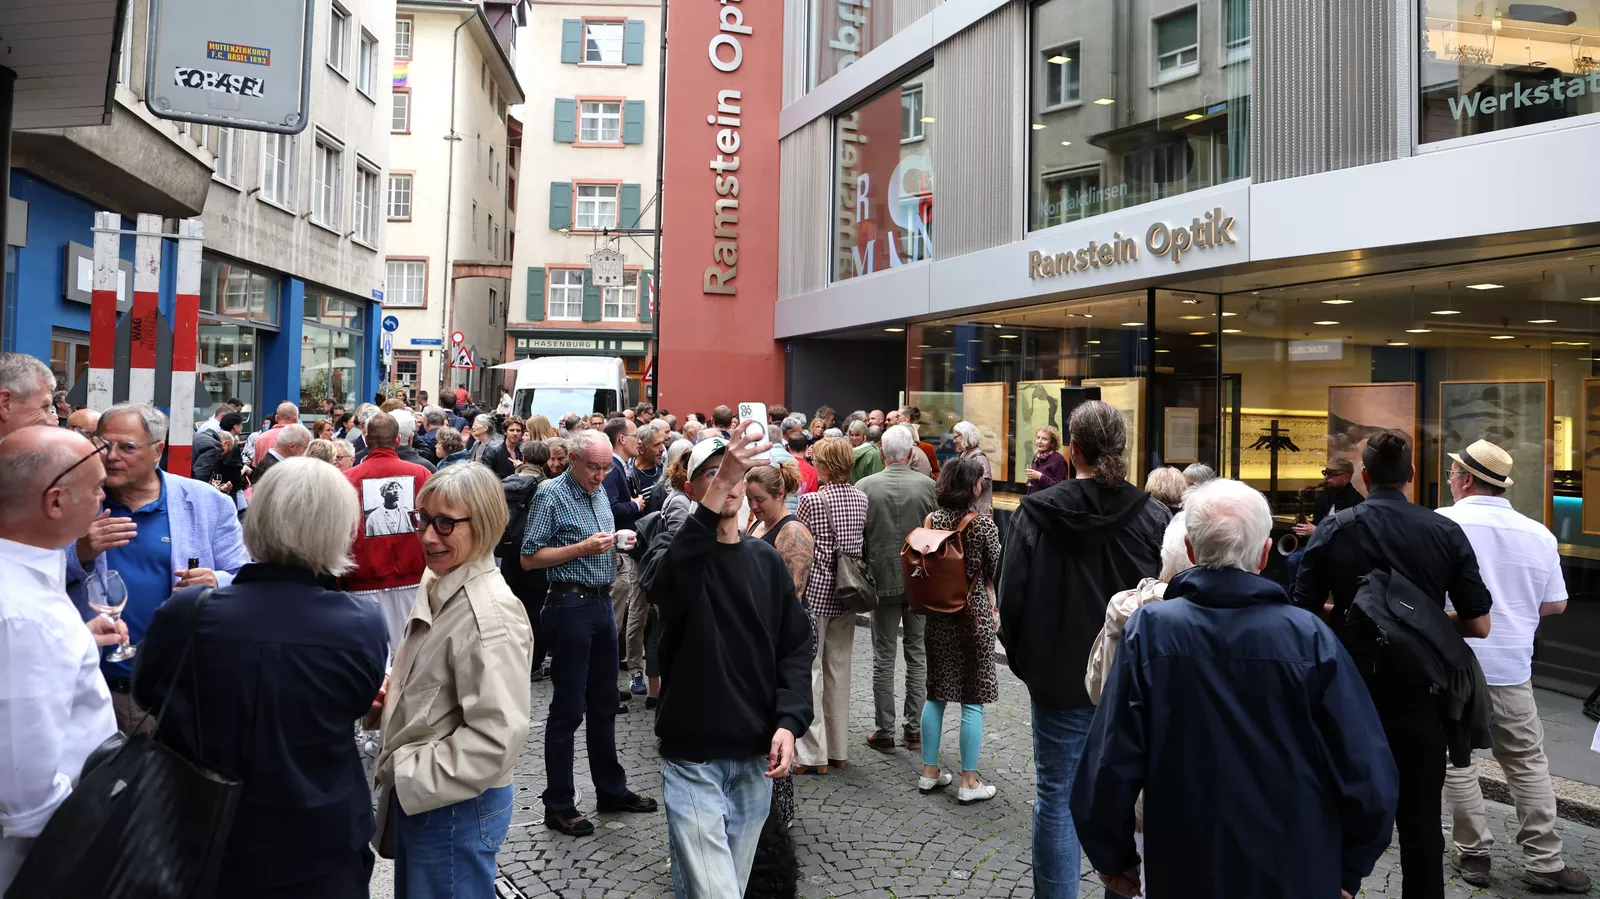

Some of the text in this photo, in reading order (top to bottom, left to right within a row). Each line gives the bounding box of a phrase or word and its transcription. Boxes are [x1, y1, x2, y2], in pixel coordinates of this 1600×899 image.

[209, 43, 269, 57] MUTTENZERKURVE
[211, 51, 267, 65] F.C. BASEL 1893
[1448, 71, 1600, 120] Werkstat
[703, 89, 742, 297] Ramstein
[1040, 182, 1128, 217] Kontaktlinsen
[1028, 207, 1236, 279] Ramstein Optik
[132, 317, 142, 341] WAG
[534, 340, 591, 348] HASENBURG
